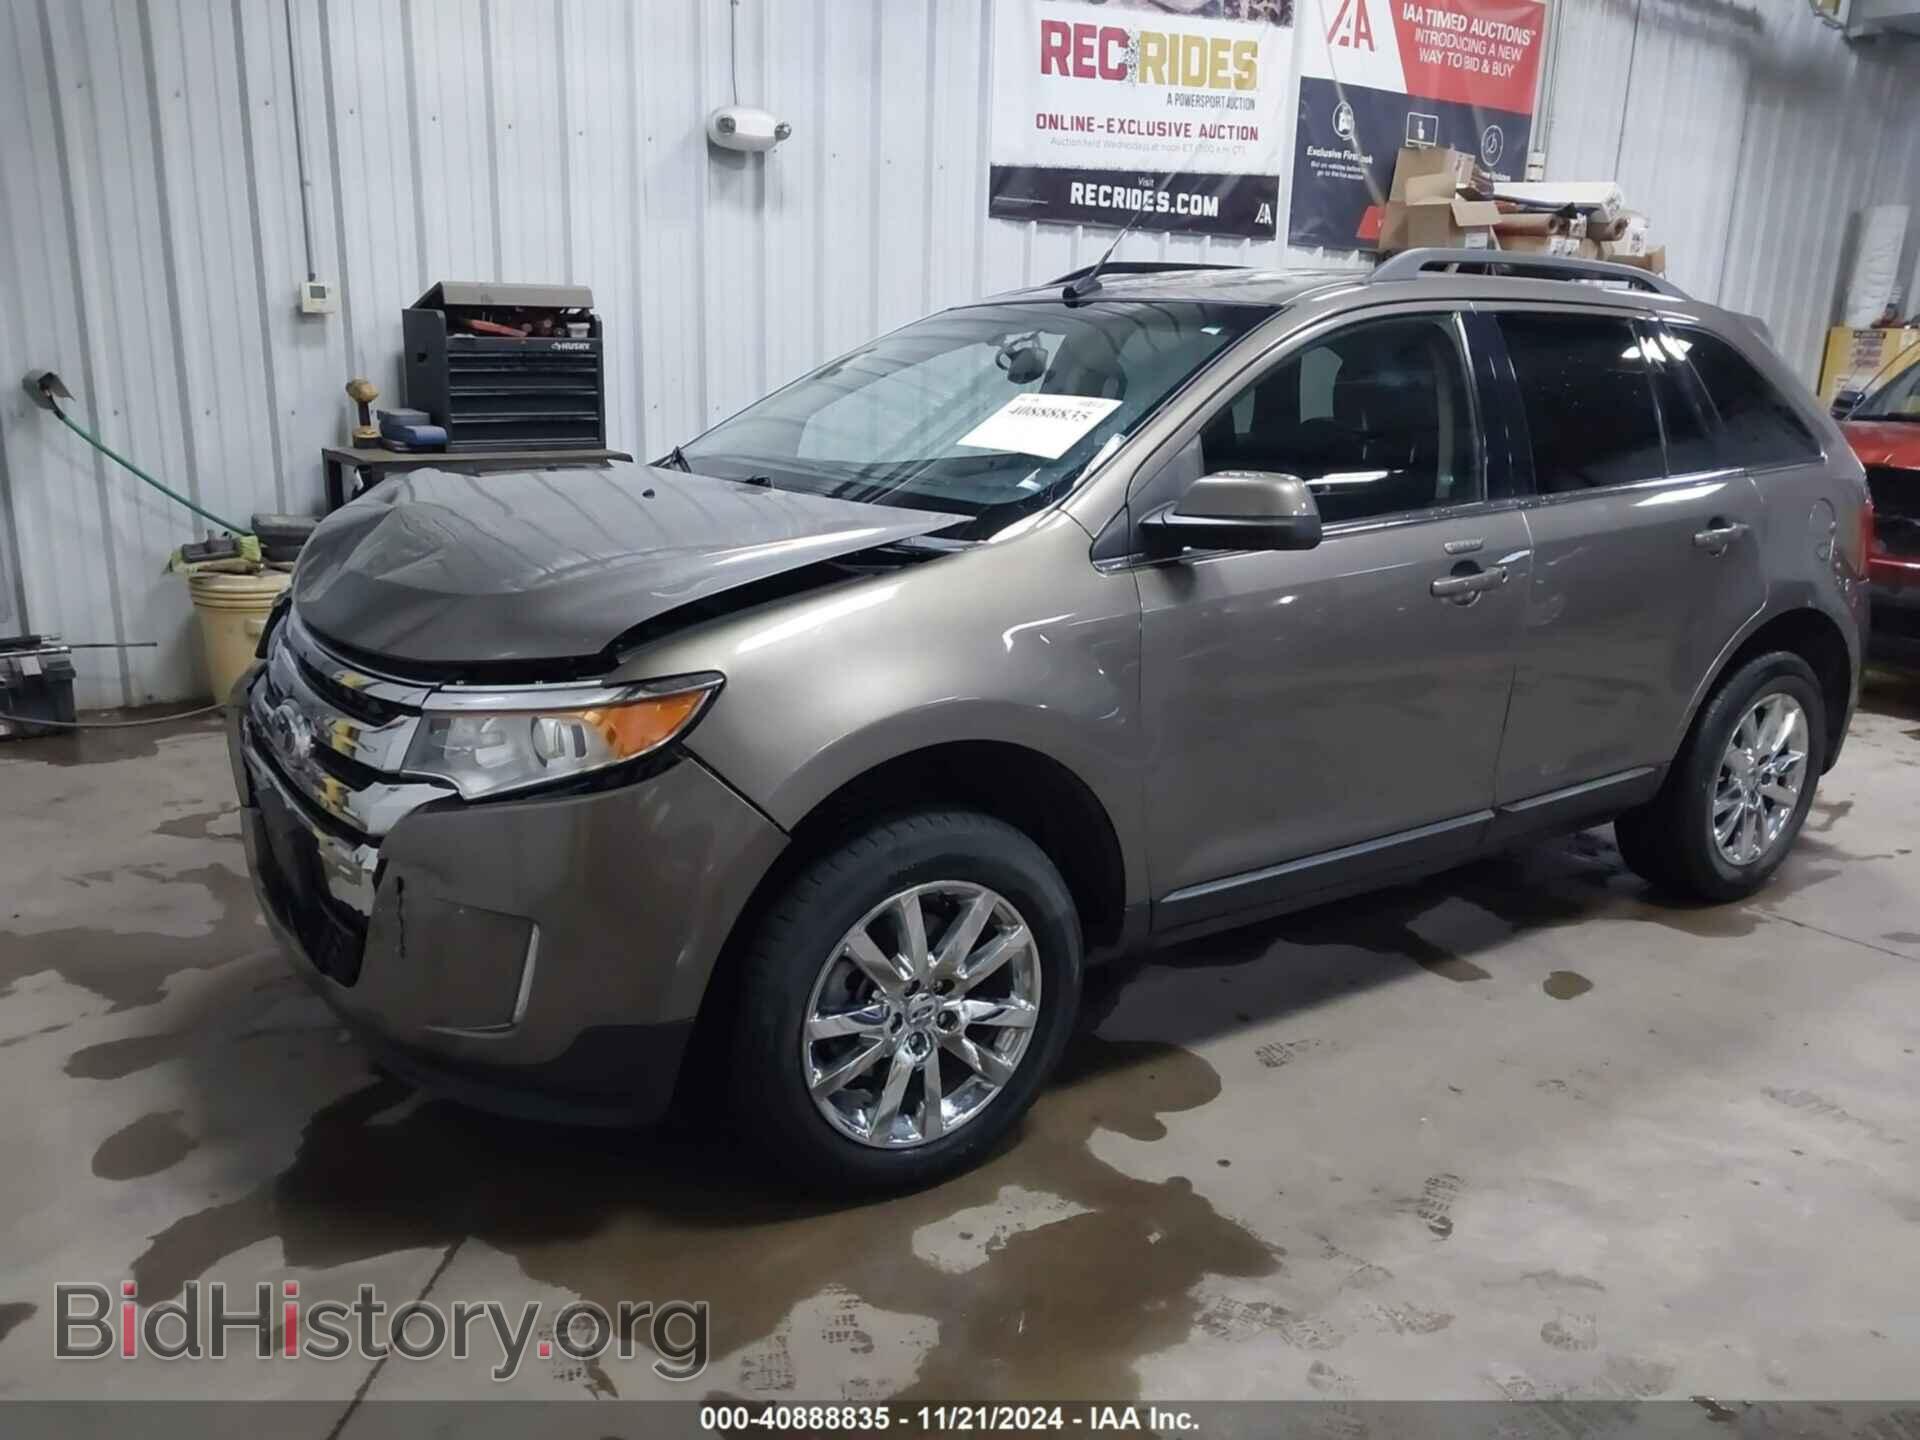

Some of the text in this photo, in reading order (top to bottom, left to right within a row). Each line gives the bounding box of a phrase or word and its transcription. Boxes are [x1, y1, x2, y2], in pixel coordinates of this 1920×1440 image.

[1402, 2, 1424, 25] IAA
[1425, 8, 1468, 33] TIMED
[1040, 19, 1259, 91] REC RIDES
[1414, 27, 1523, 61] INTRODUCING A NEW
[1419, 47, 1515, 78] WAY TO BID & BUY
[1166, 92, 1256, 111] A POWERSPORT AUCTION
[1035, 113, 1259, 142] ONLINE-EXCLUSIVE AUCTION
[1306, 145, 1342, 160] Exclusive
[1138, 176, 1154, 187] Visit
[1070, 182, 1219, 217] RECRIDES.COM
